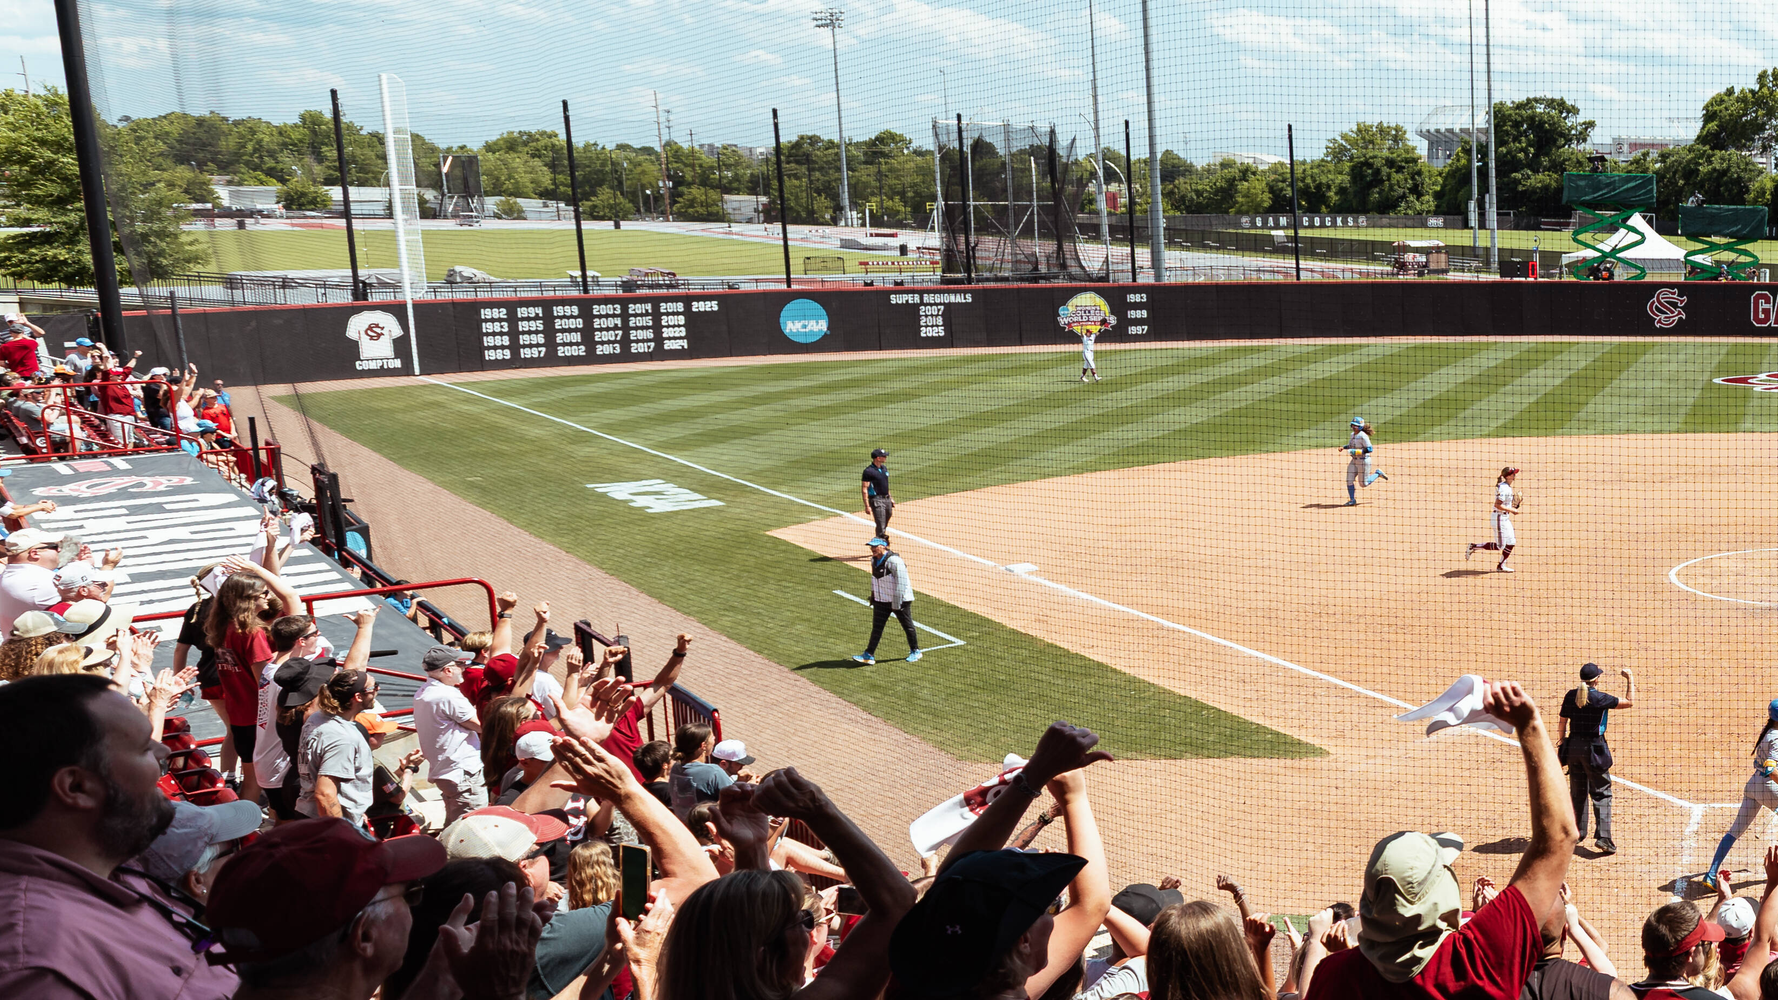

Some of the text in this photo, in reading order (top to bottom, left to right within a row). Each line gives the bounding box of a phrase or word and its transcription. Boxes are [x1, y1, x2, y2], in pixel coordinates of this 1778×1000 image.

[890, 293, 972, 304] SUPER REGIONALS
[1126, 293, 1147, 302] 1983
[480, 301, 719, 319] 1982 1994 1999 2003 2014 2018 2025
[919, 306, 944, 316] 2007
[1127, 310, 1147, 318] 1989
[482, 322, 509, 333] 1983
[518, 320, 544, 331] 1995
[554, 318, 583, 329] 2000
[593, 317, 622, 328] 2004
[628, 316, 653, 327] 2015
[920, 316, 943, 326] 2018
[1060, 315, 1088, 324] WORLD
[786, 320, 827, 332] NCAA
[920, 326, 945, 337] 2025
[1128, 326, 1148, 335] 1997
[483, 327, 686, 346] 1988 1996 2001 2007 2016 2023
[484, 339, 688, 360] 1989 1997 2002 2013 2017 2024
[355, 358, 401, 370] COMPTON
